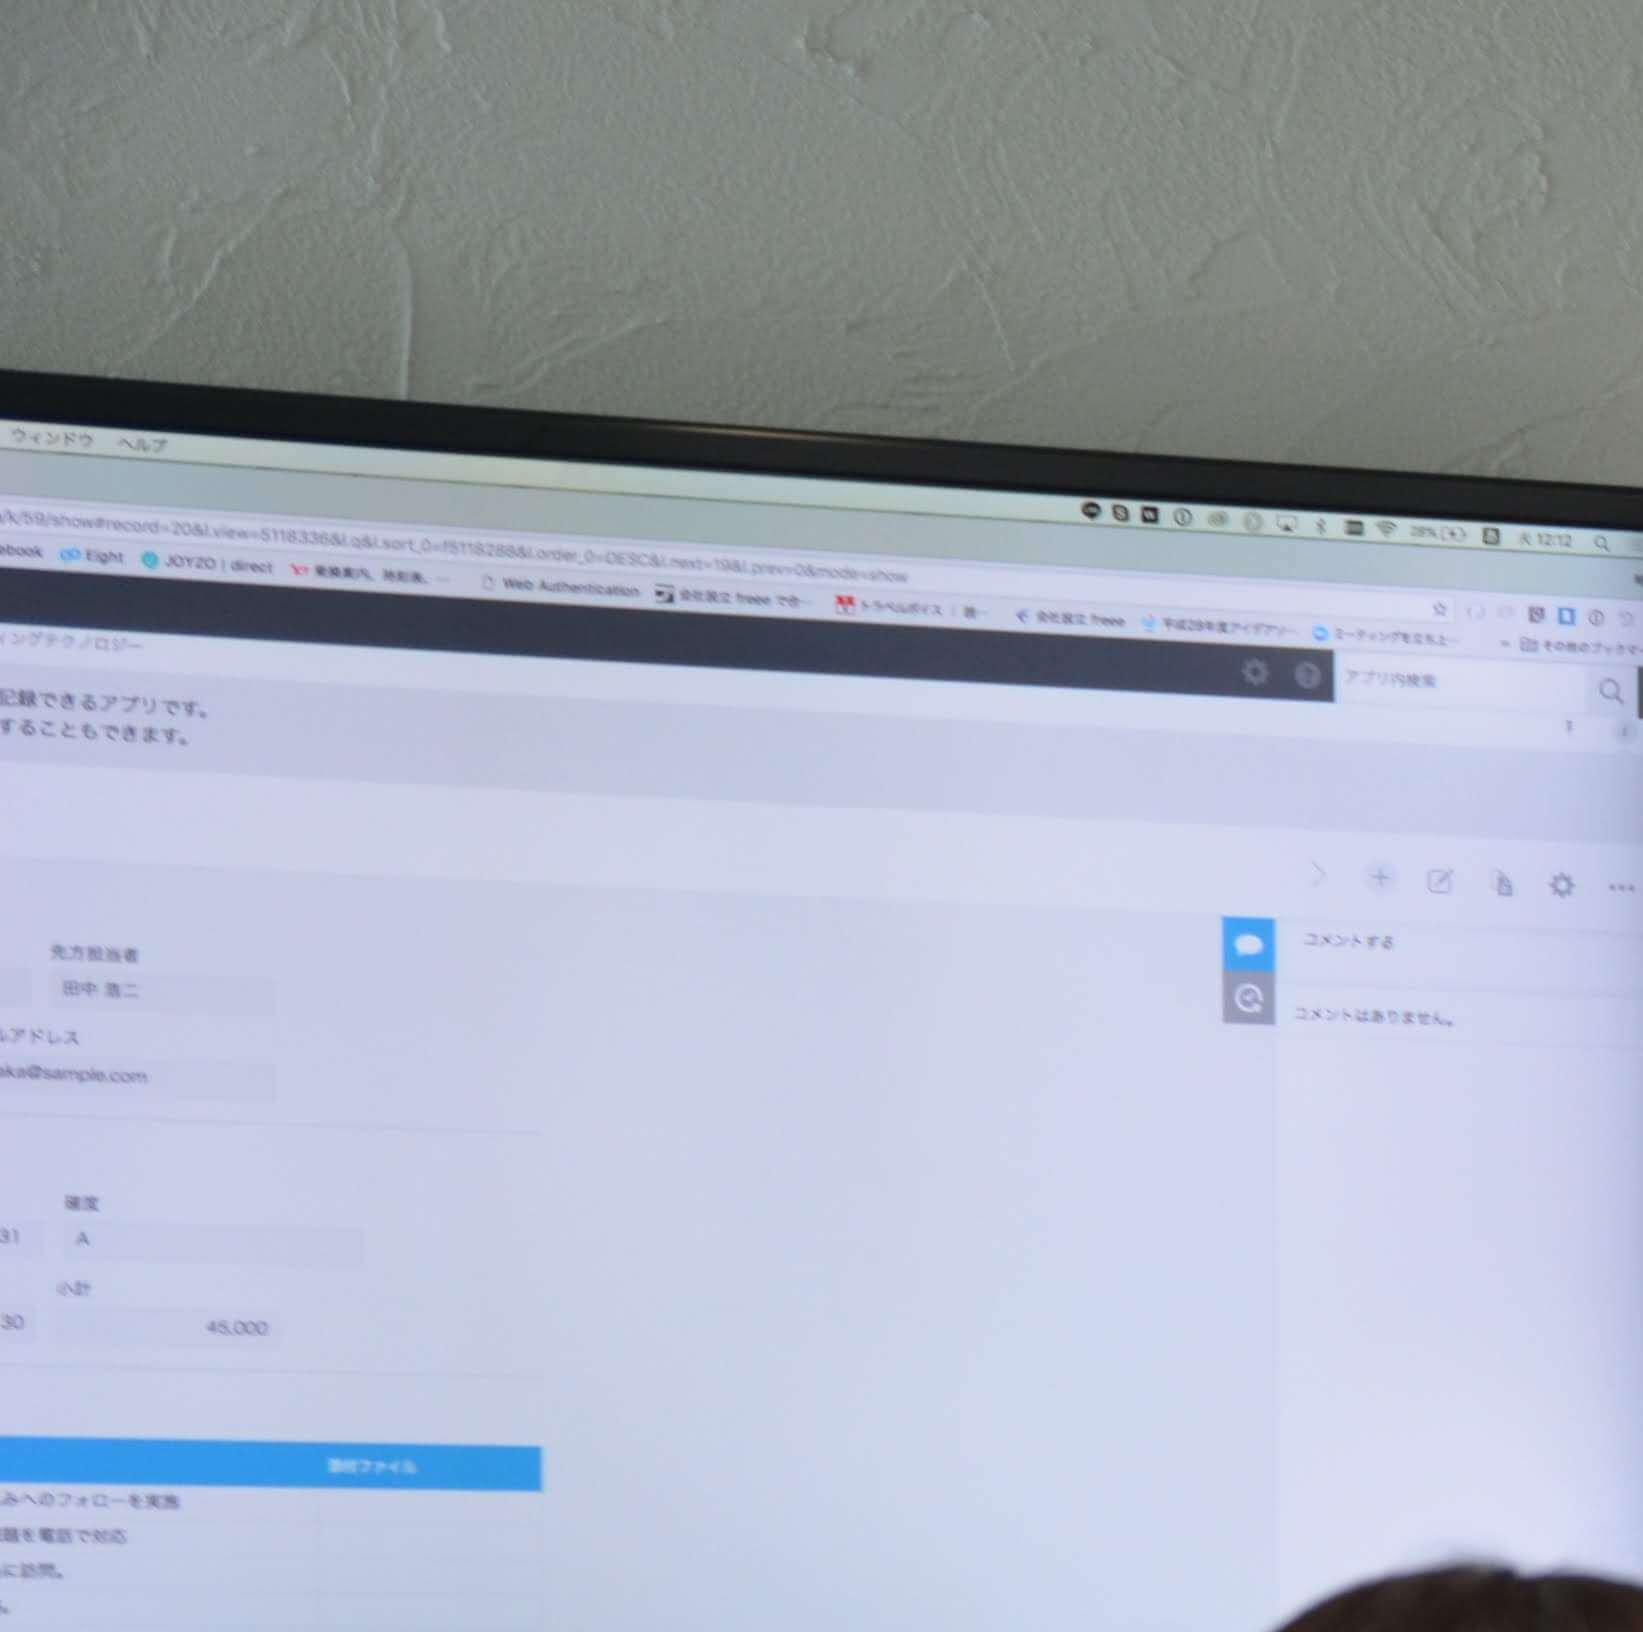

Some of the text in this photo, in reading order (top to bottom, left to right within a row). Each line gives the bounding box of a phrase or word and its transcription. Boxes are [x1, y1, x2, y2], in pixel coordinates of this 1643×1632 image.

[85, 547, 125, 566] Eight
[230, 559, 274, 575] direct
[502, 575, 535, 592] Web
